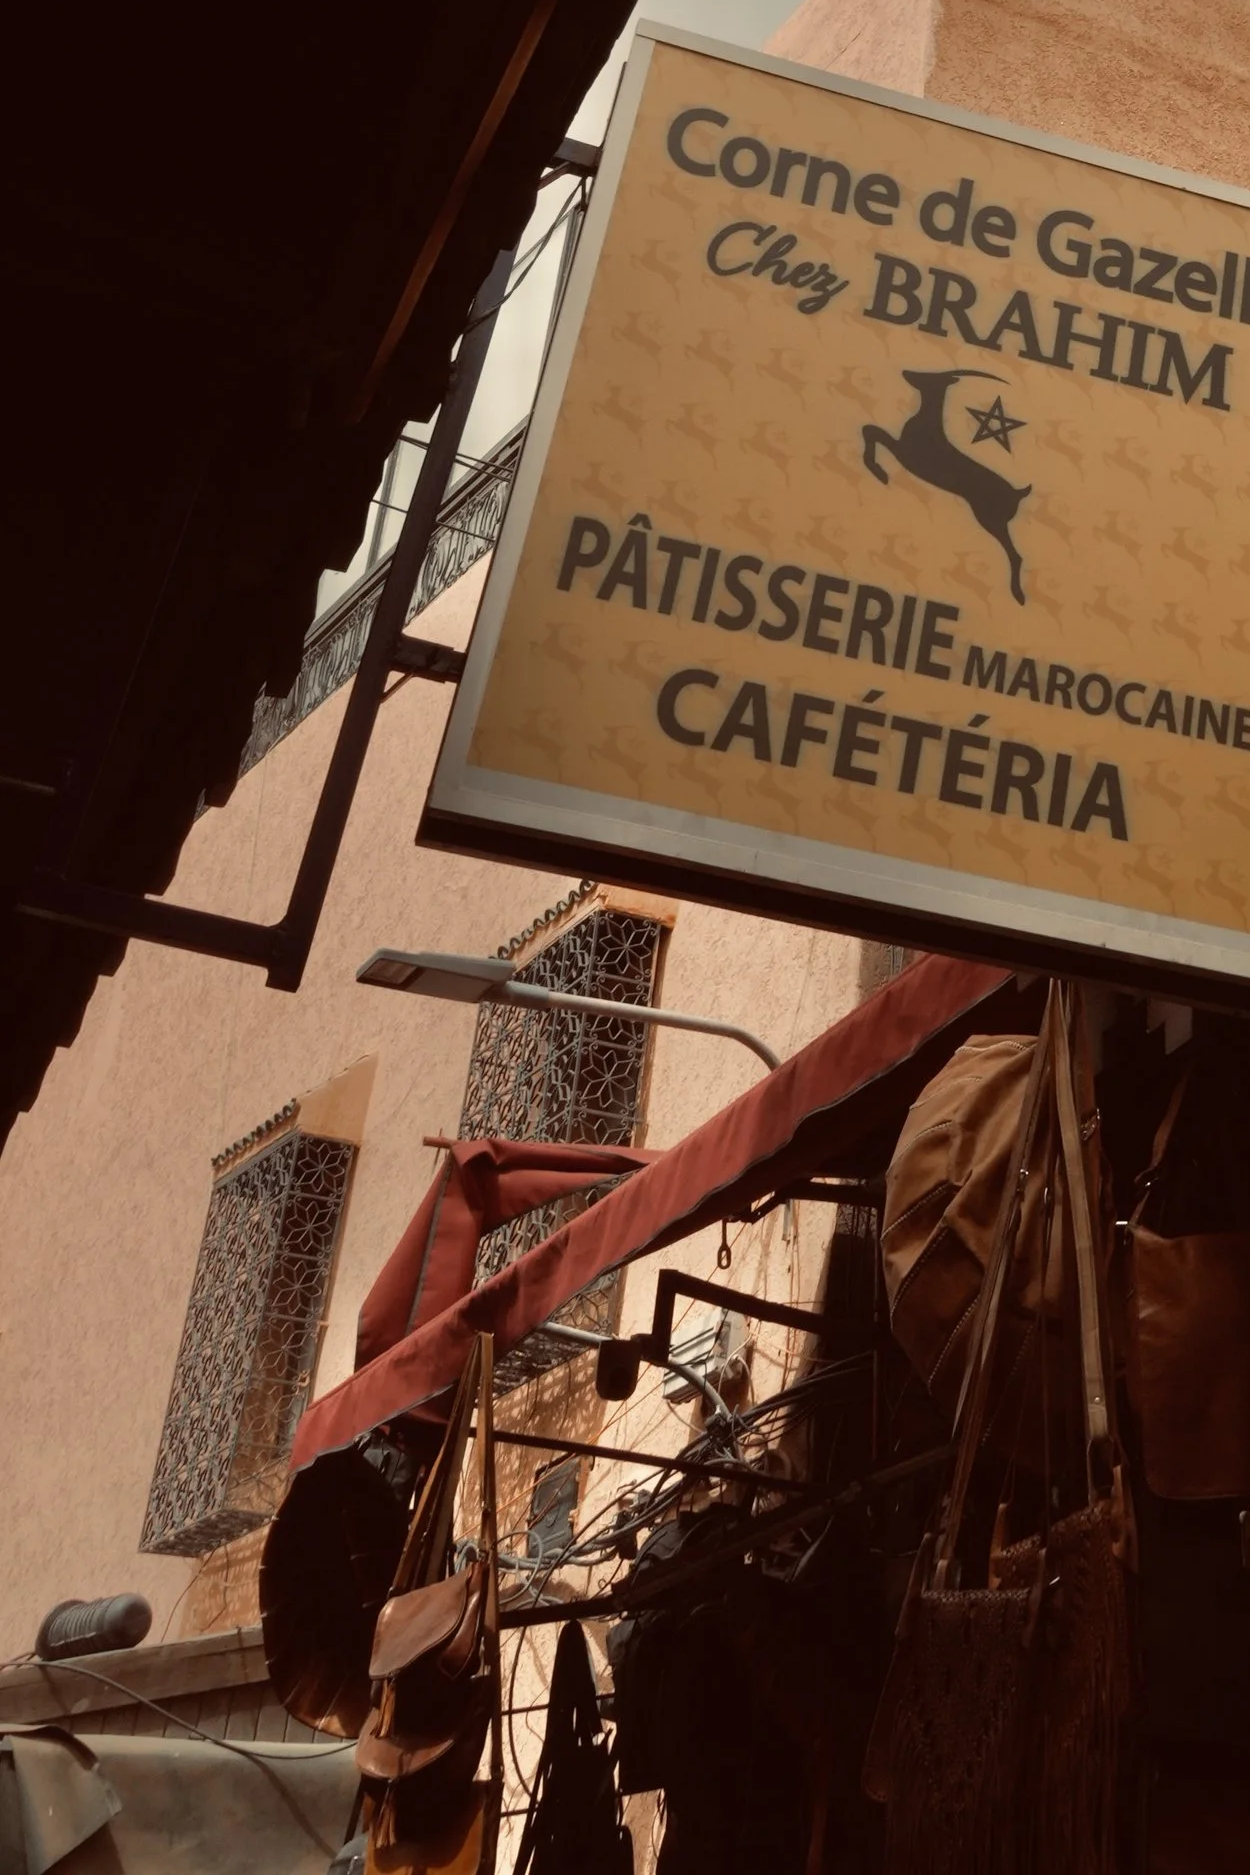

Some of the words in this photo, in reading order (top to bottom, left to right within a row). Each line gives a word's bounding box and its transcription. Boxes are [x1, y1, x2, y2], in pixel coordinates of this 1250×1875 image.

[666, 107, 900, 225] Corne
[919, 178, 1016, 257] de
[705, 221, 850, 314] Chez
[864, 255, 1233, 411] BRAHIM
[556, 513, 961, 680] PÂTISSERIE
[656, 669, 1129, 841] CAFÉTÉRIA
